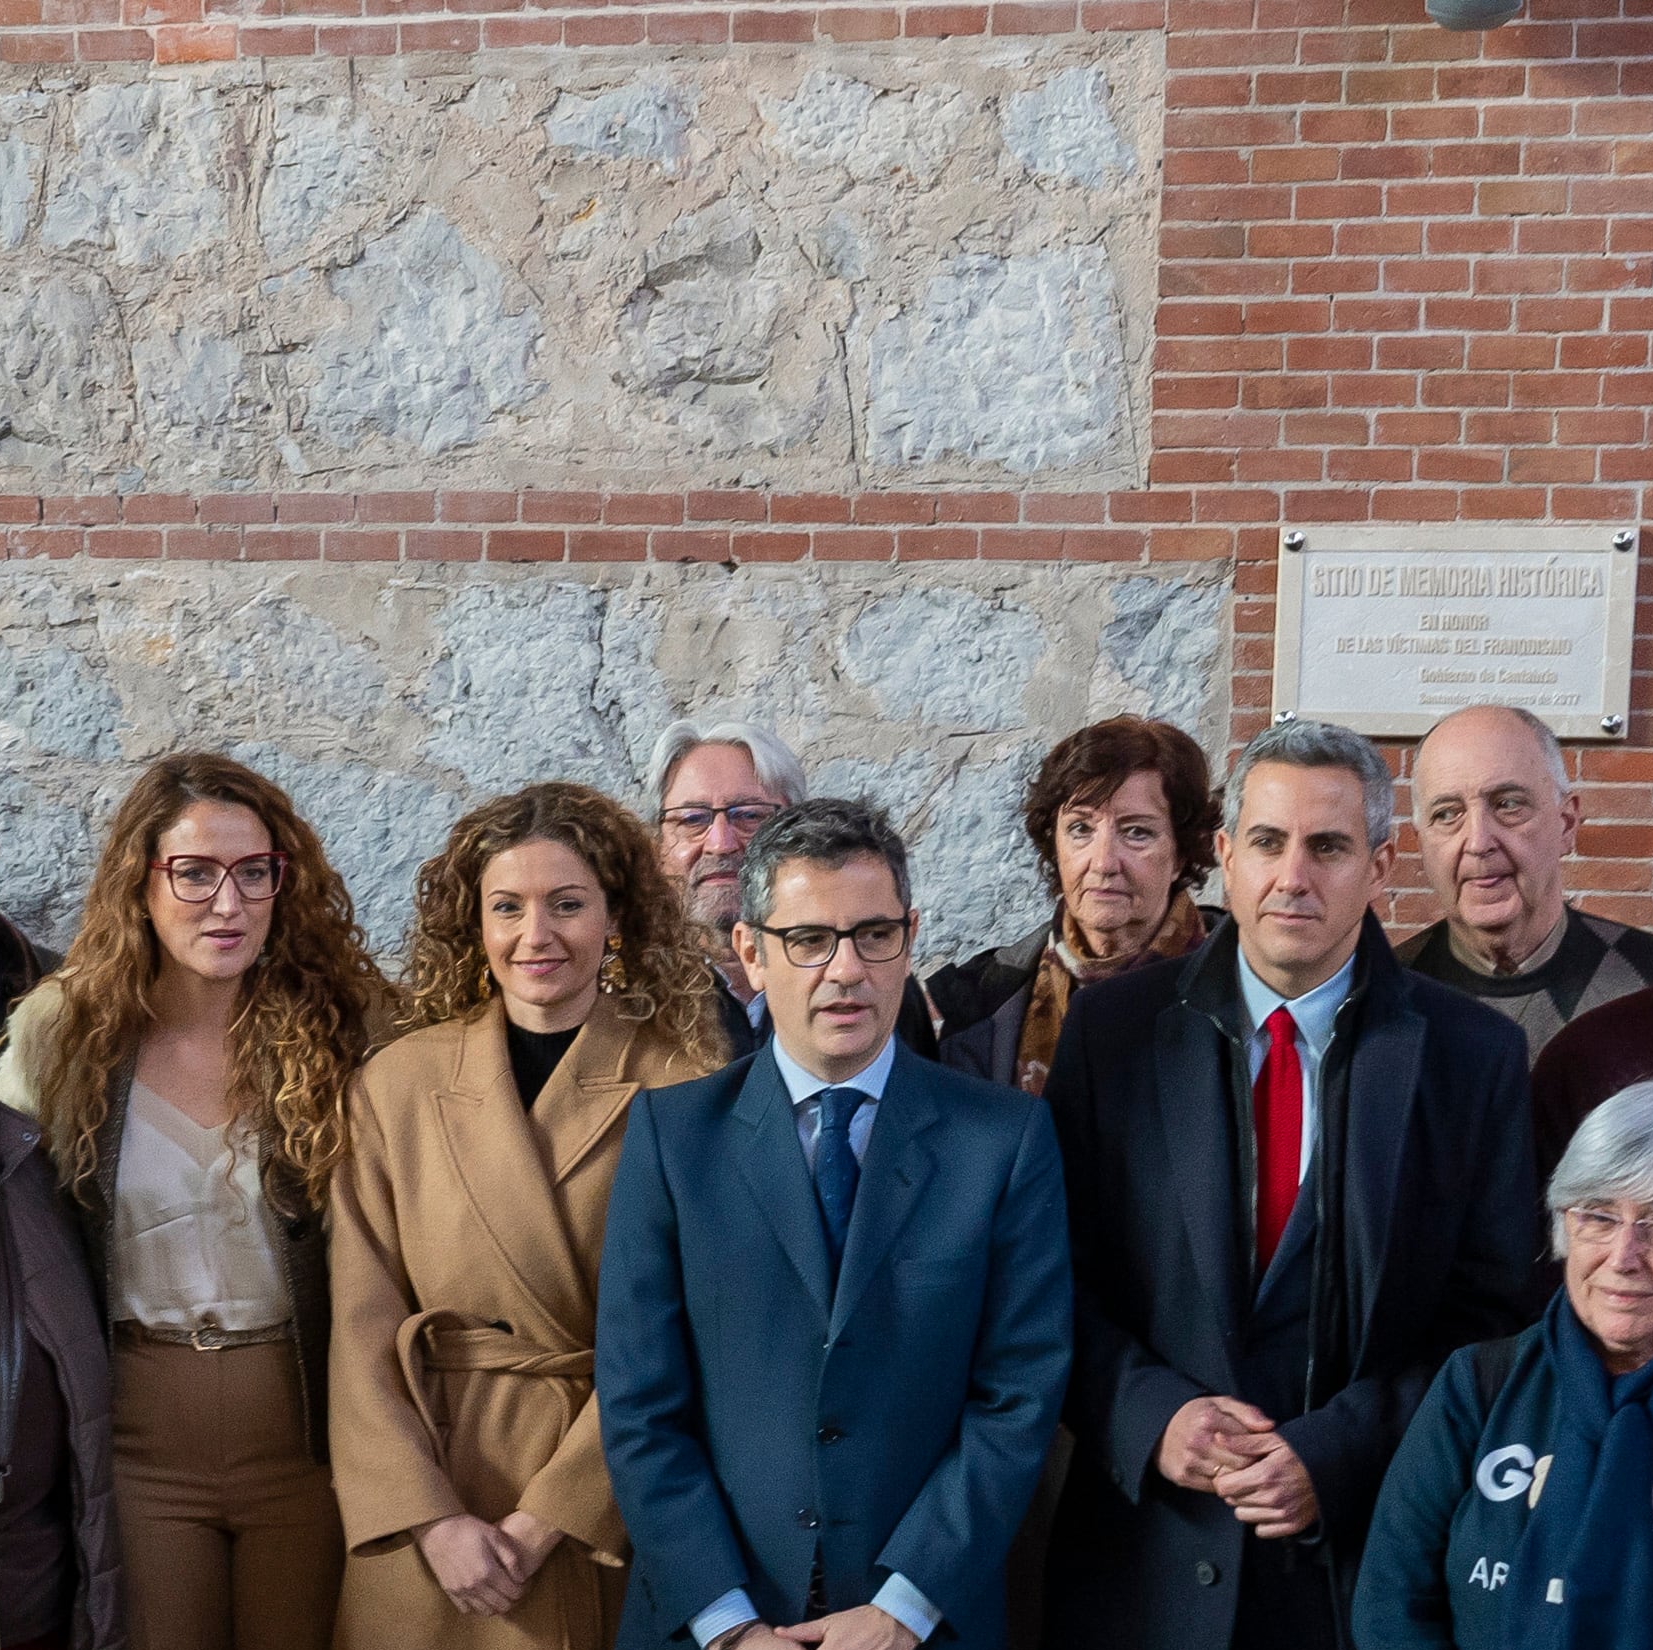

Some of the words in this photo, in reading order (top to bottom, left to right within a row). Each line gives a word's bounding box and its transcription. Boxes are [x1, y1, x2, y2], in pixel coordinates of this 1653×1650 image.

[1311, 564, 1362, 598] SITIO
[1366, 565, 1395, 598] DE
[1399, 565, 1493, 598] MEMORIA
[1496, 556, 1604, 598] HISTÓRICA
[1418, 613, 1440, 631] EN
[1443, 613, 1490, 631] HONOR
[1335, 637, 1354, 654] DE
[1356, 637, 1382, 654] LAS
[1385, 632, 1449, 655] VÍCTIMAS
[1452, 638, 1481, 655] DEL
[1483, 638, 1573, 657] FRANQUISMO
[1420, 667, 1476, 684] Gobierno
[1497, 667, 1559, 684] Cantabria
